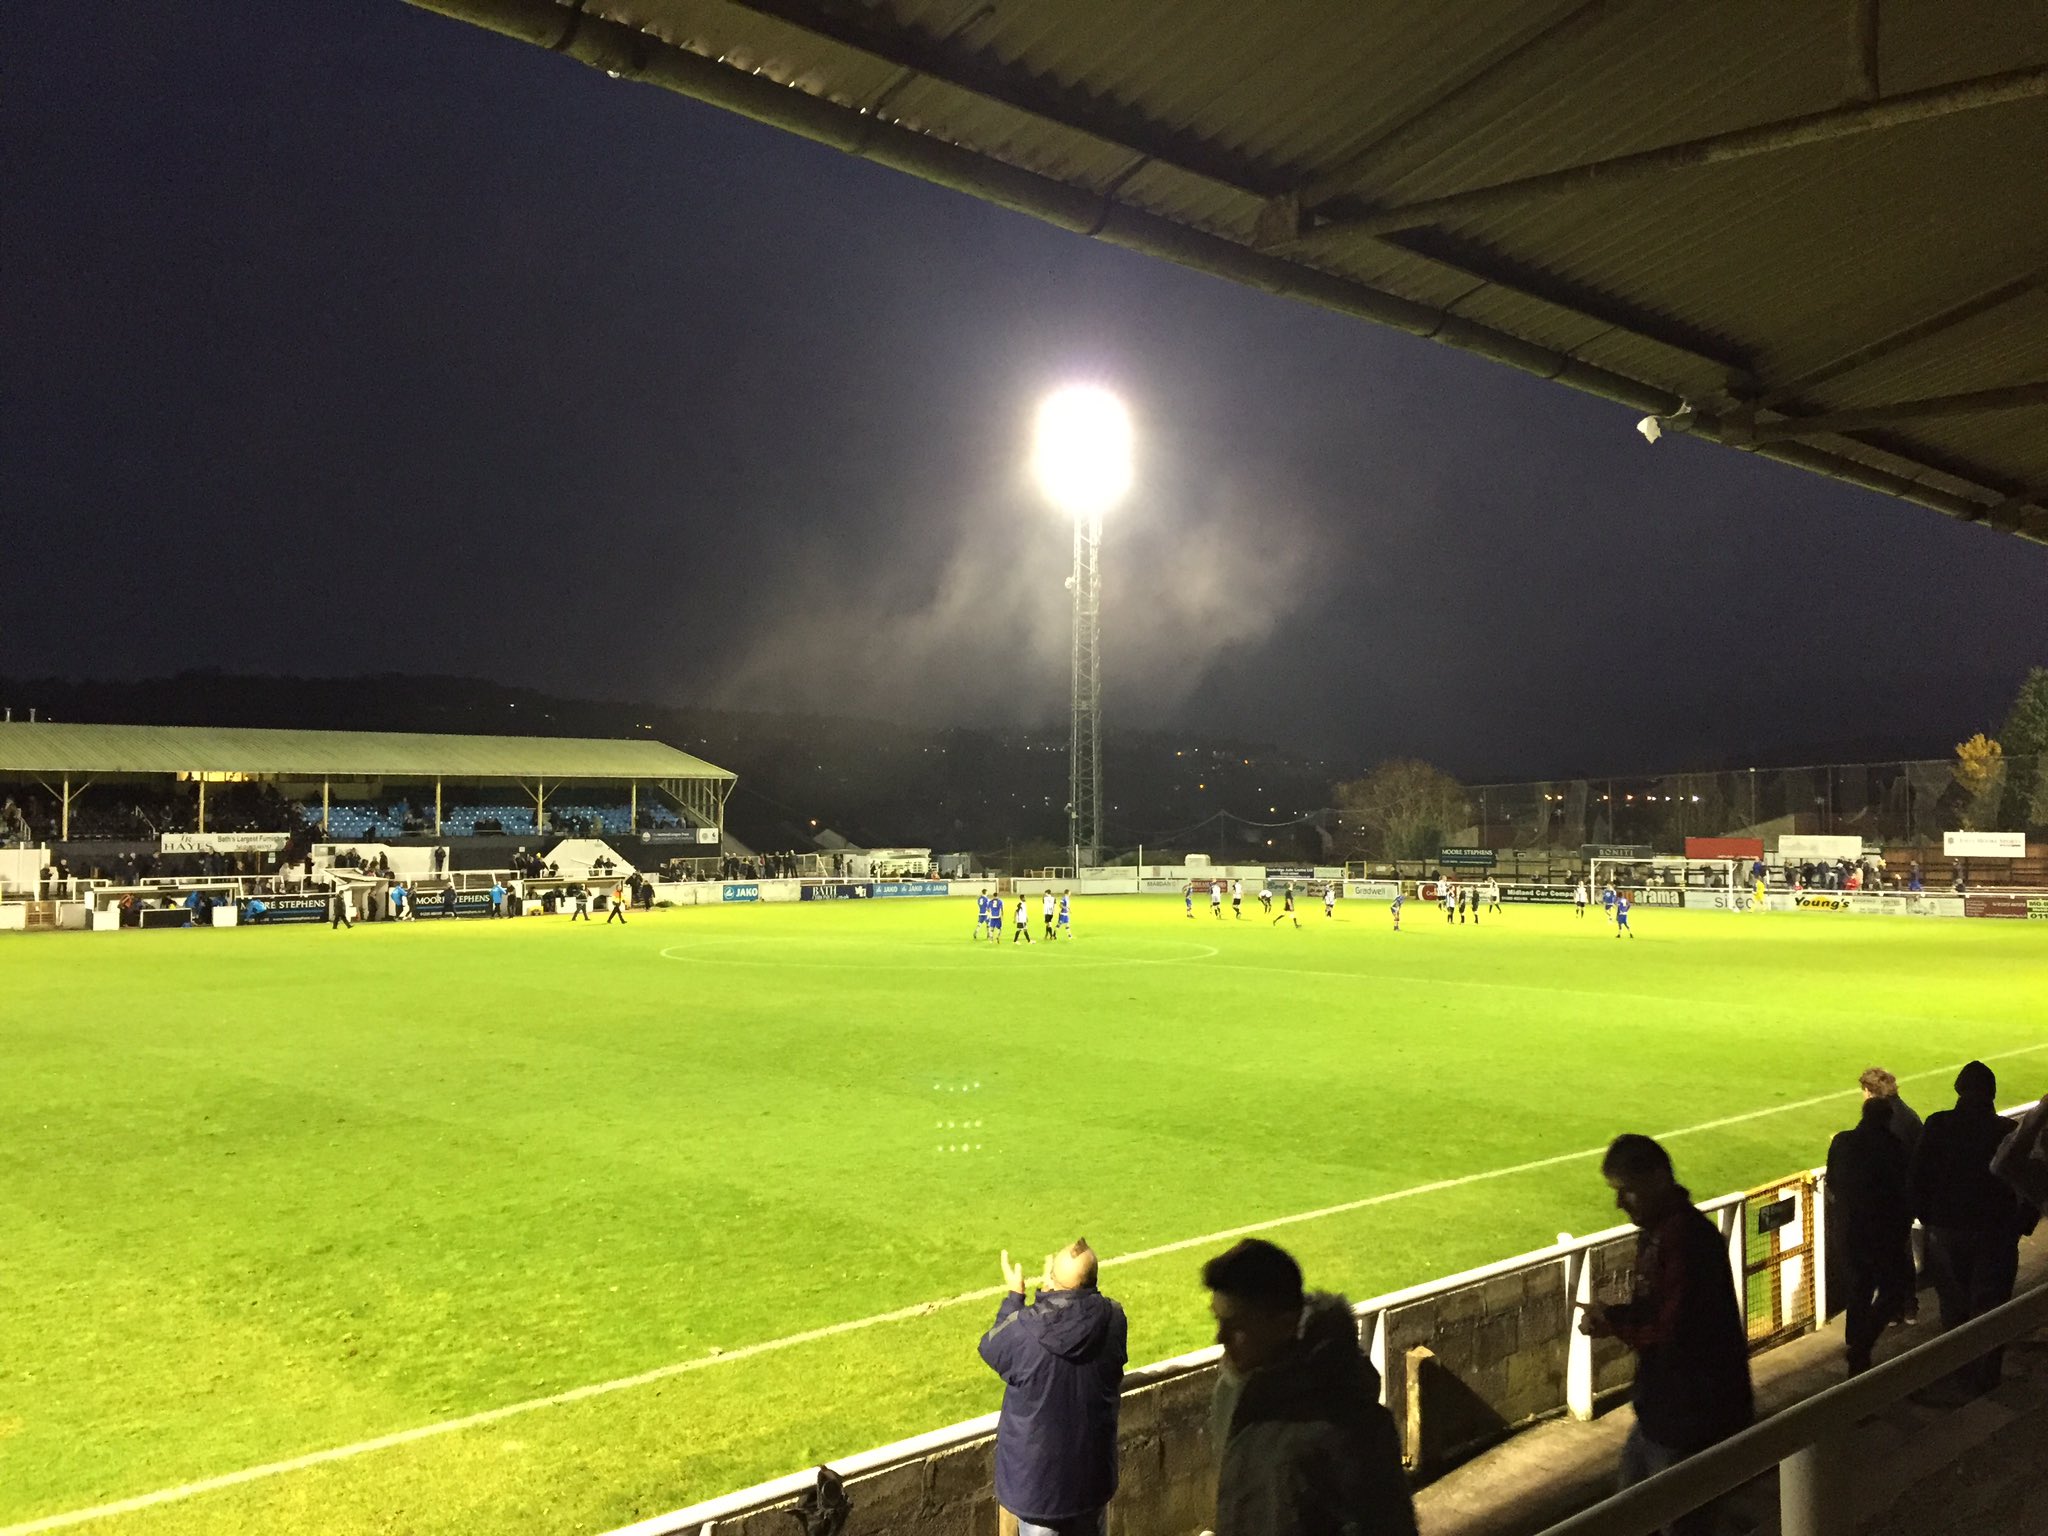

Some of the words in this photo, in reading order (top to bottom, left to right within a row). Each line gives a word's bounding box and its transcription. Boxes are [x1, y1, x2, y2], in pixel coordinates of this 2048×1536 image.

[164, 843, 214, 851] HAYES
[735, 887, 758, 897] JAKO
[1355, 886, 1386, 895] Gradwell
[454, 895, 490, 904] TEPHENS
[1795, 896, 1850, 910] Young's
[240, 900, 276, 910] MRE
[279, 899, 326, 909] STEPHENS
